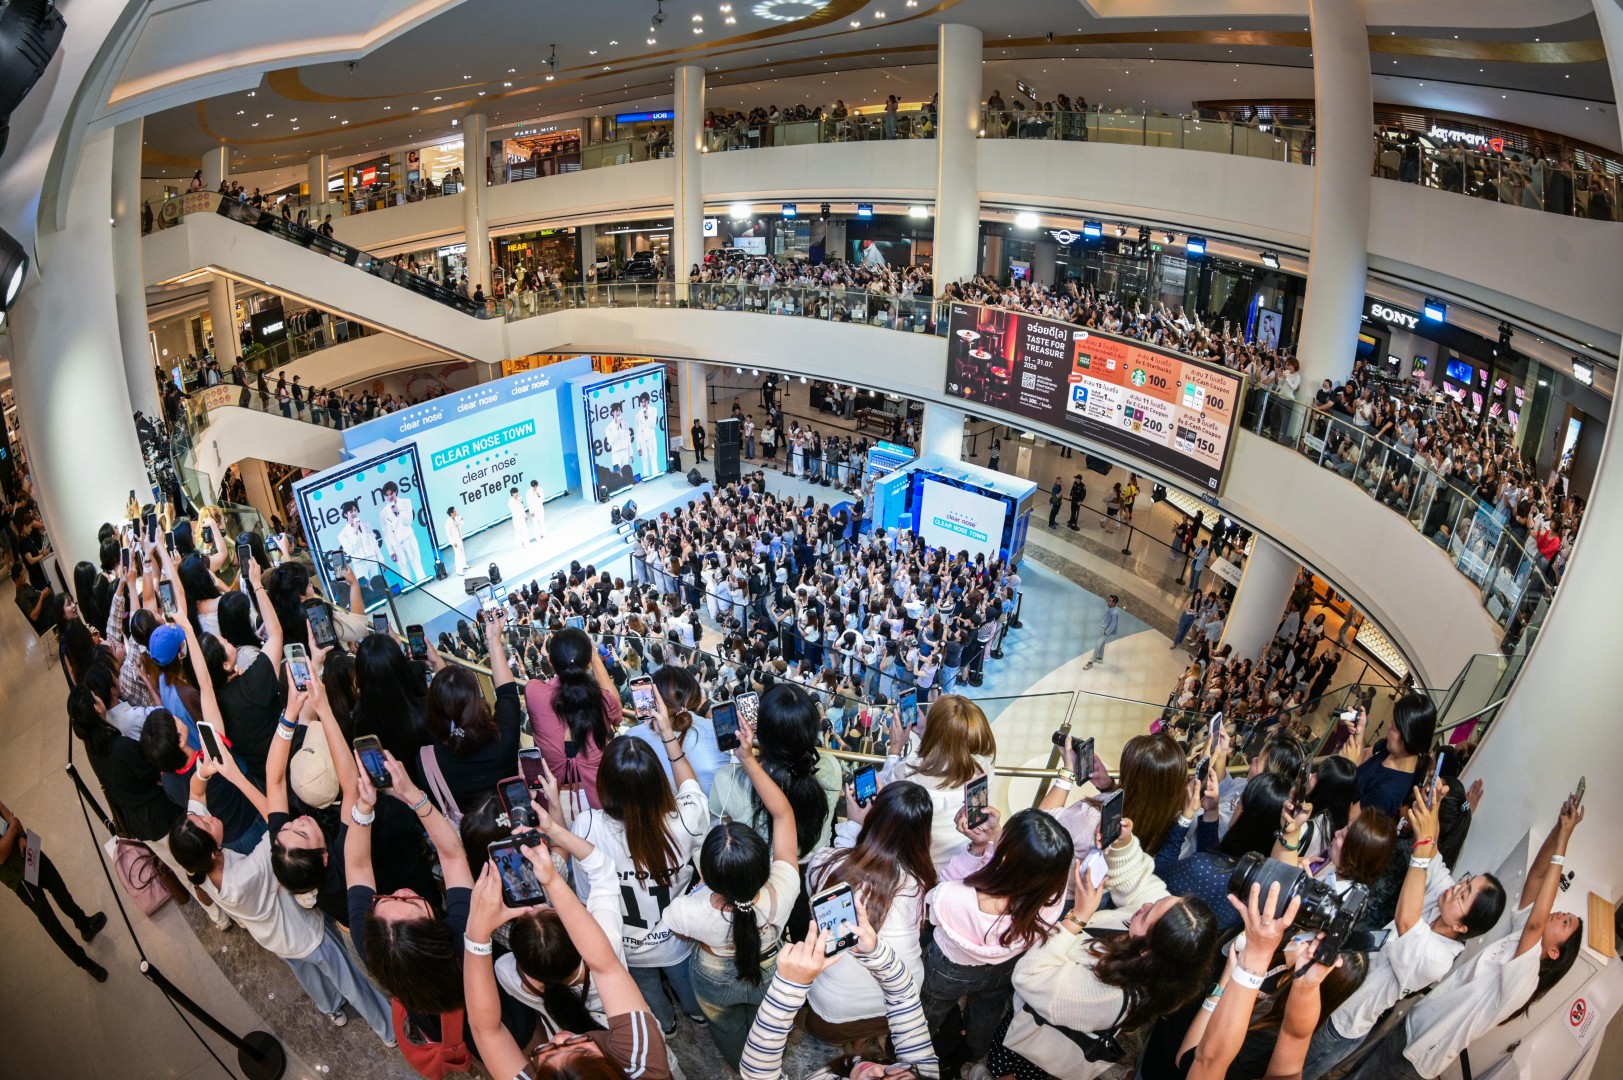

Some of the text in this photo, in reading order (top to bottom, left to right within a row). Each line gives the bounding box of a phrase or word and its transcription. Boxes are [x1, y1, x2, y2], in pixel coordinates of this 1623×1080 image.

[514, 128, 537, 136] PARIS
[508, 242, 528, 252] HEAR
[1372, 304, 1419, 329] SONY
[1027, 323, 1068, 340] อร่อยดี[ล]
[1027, 335, 1065, 350] TASTE FOR
[1026, 343, 1064, 359] TREASURE
[1142, 360, 1172, 374] E-Starbucks
[512, 379, 549, 395] clear nose
[1149, 374, 1166, 388] 100
[1192, 377, 1209, 387] E-Cash
[1210, 382, 1230, 394] Coupon
[457, 394, 498, 413] clear nose
[1206, 394, 1224, 410] 100
[1133, 403, 1149, 411] E-Cash
[1150, 408, 1168, 418] Coupon
[400, 412, 443, 432] clear nose
[1143, 417, 1162, 432] 200
[1185, 421, 1201, 432] E-Cash
[1202, 426, 1222, 440] Coupon
[435, 422, 532, 467] CLEAR NOSE TOWN
[1196, 437, 1214, 454] 150
[462, 458, 516, 484] clear nose
[1202, 495, 1213, 504] Plan
[946, 514, 976, 528] clear nose
[934, 520, 987, 541] CLEAR NOSE TOWN
[820, 917, 837, 930] Por
